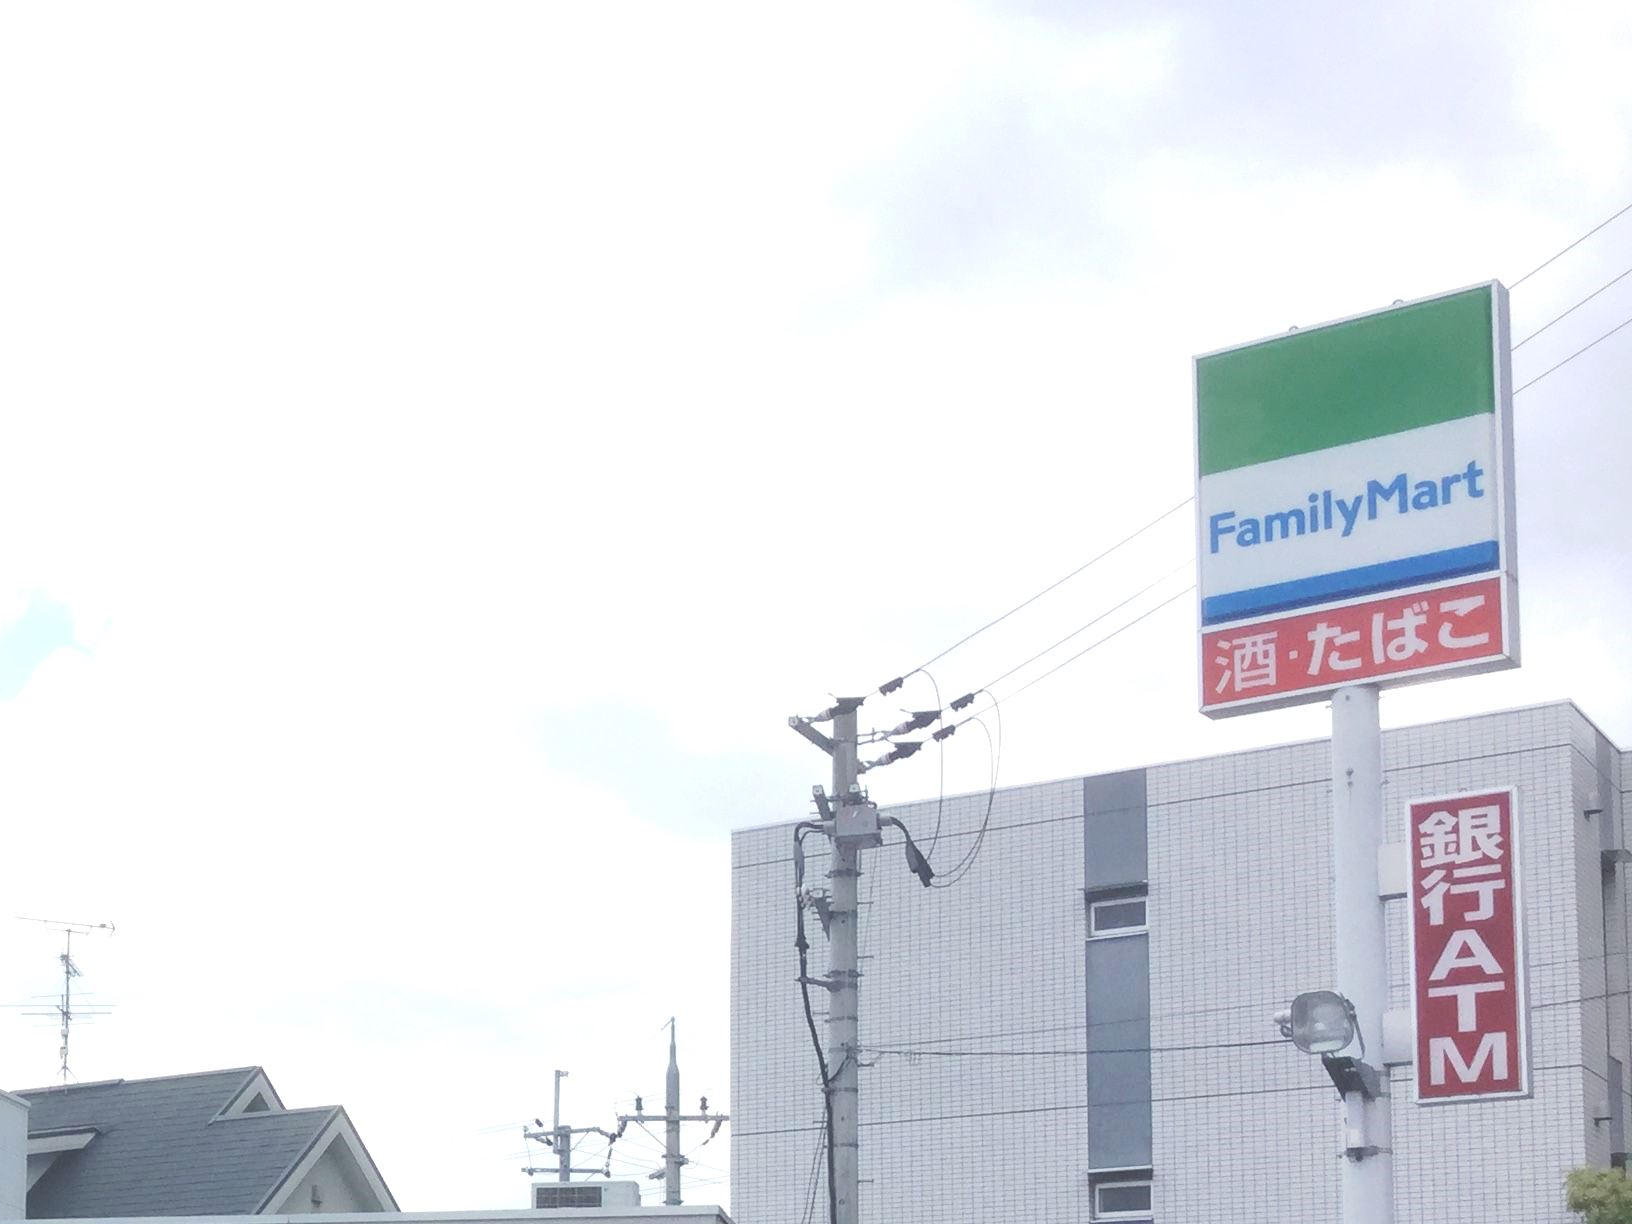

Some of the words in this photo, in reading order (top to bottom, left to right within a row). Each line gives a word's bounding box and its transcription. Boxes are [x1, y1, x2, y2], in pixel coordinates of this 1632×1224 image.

[1209, 460, 1485, 554] FamilyMart
[1215, 596, 1488, 694] 酒・たばこ
[1418, 804, 1509, 1086] 銀行ATM
